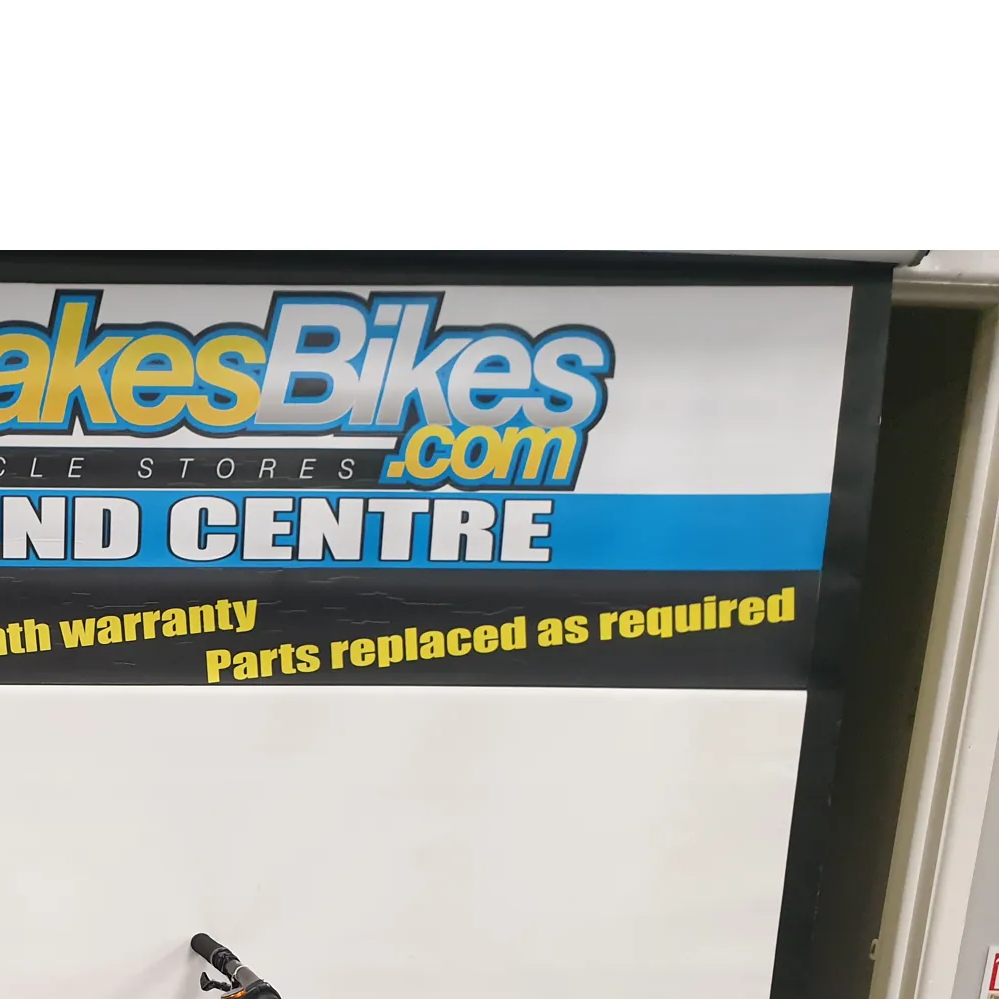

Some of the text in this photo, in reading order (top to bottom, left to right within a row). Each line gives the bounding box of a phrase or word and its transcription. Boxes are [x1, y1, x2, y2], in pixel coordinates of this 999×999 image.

[138, 456, 357, 480] STORES
[167, 496, 553, 563] CENTRE
[61, 598, 258, 650] warranty
[205, 587, 796, 684] Parts replaced as required
